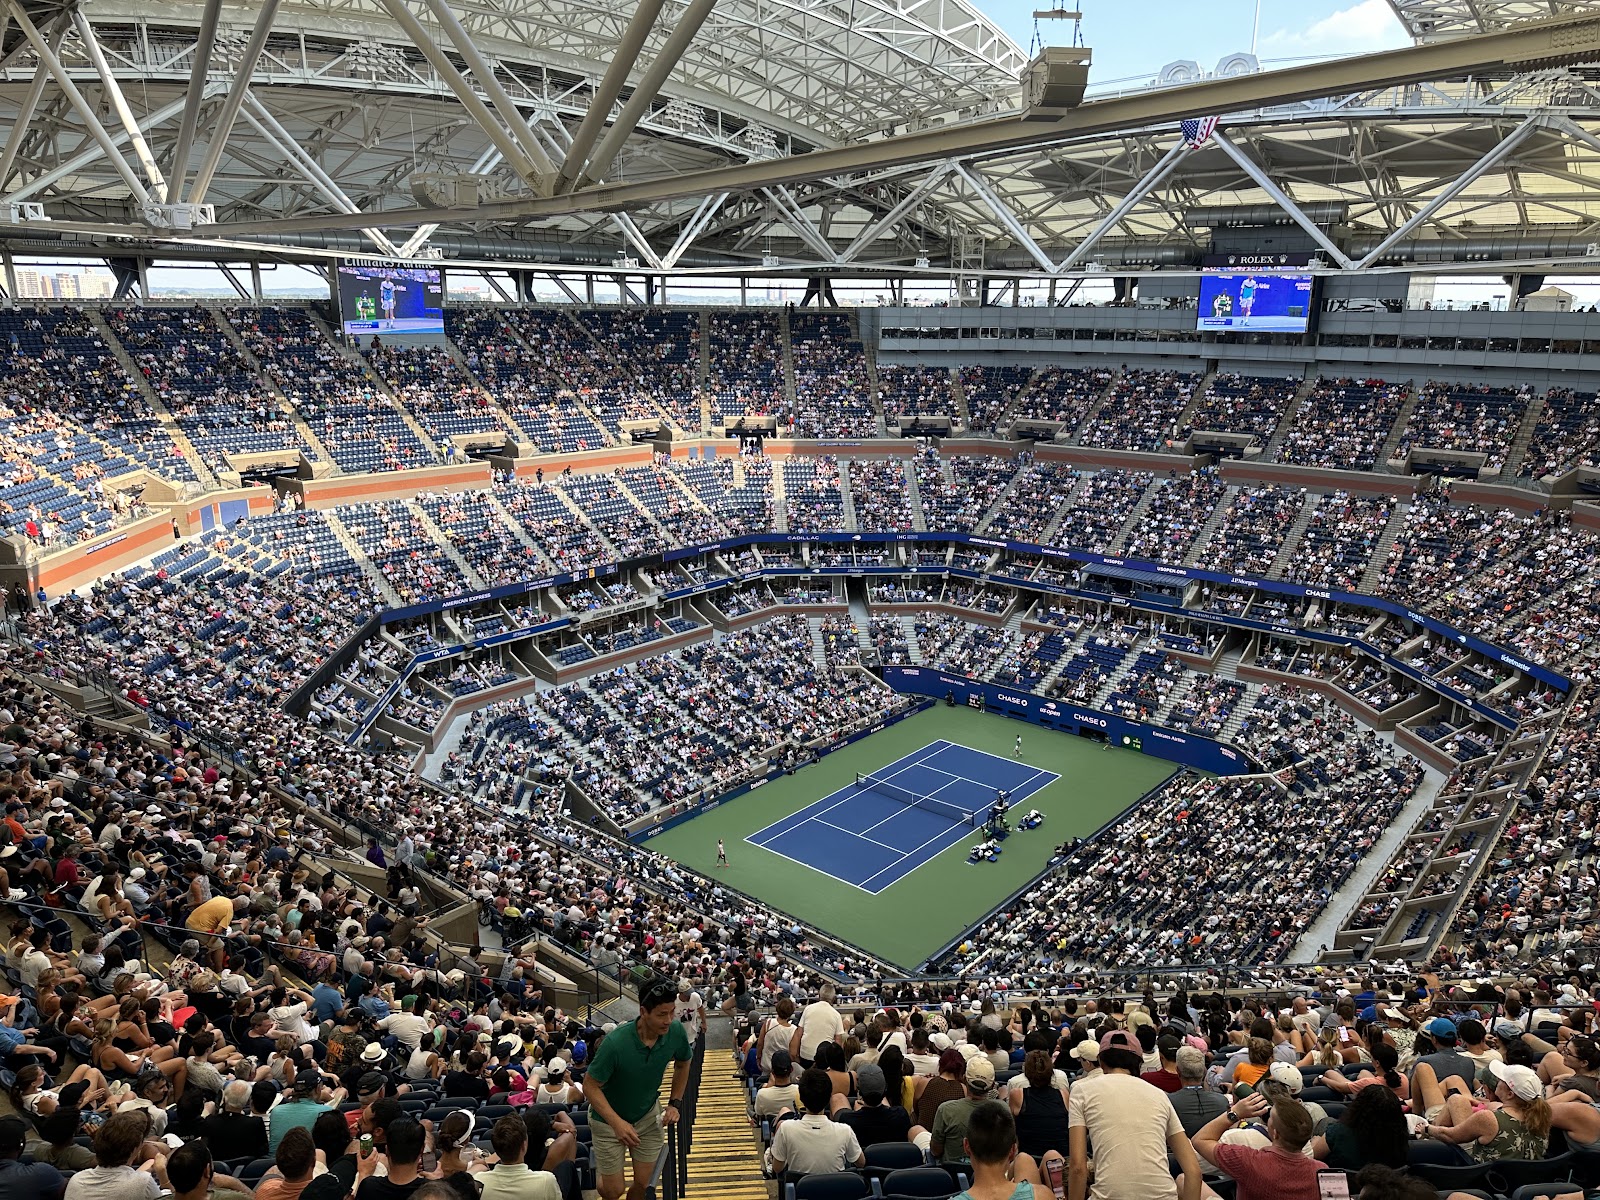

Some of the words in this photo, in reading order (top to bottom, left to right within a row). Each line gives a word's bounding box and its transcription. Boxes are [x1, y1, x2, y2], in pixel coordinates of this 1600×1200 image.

[1240, 256, 1274, 264] ROLEX
[1156, 566, 1187, 575] USOPEN.ORG
[1231, 577, 1259, 587] J.P.Morgan
[1305, 589, 1331, 599] CHASE
[441, 597, 469, 608] AMERICAN
[469, 592, 492, 603] EXPRESS
[1407, 611, 1425, 623] DOBEL
[1271, 625, 1297, 635] FAGE
[433, 649, 450, 658] WTA
[1500, 654, 1531, 672] ticketmaster
[1421, 675, 1437, 688] CHASE
[997, 693, 1021, 706] CHASE
[1073, 713, 1099, 726] CHASE
[870, 723, 885, 733] FAGE
